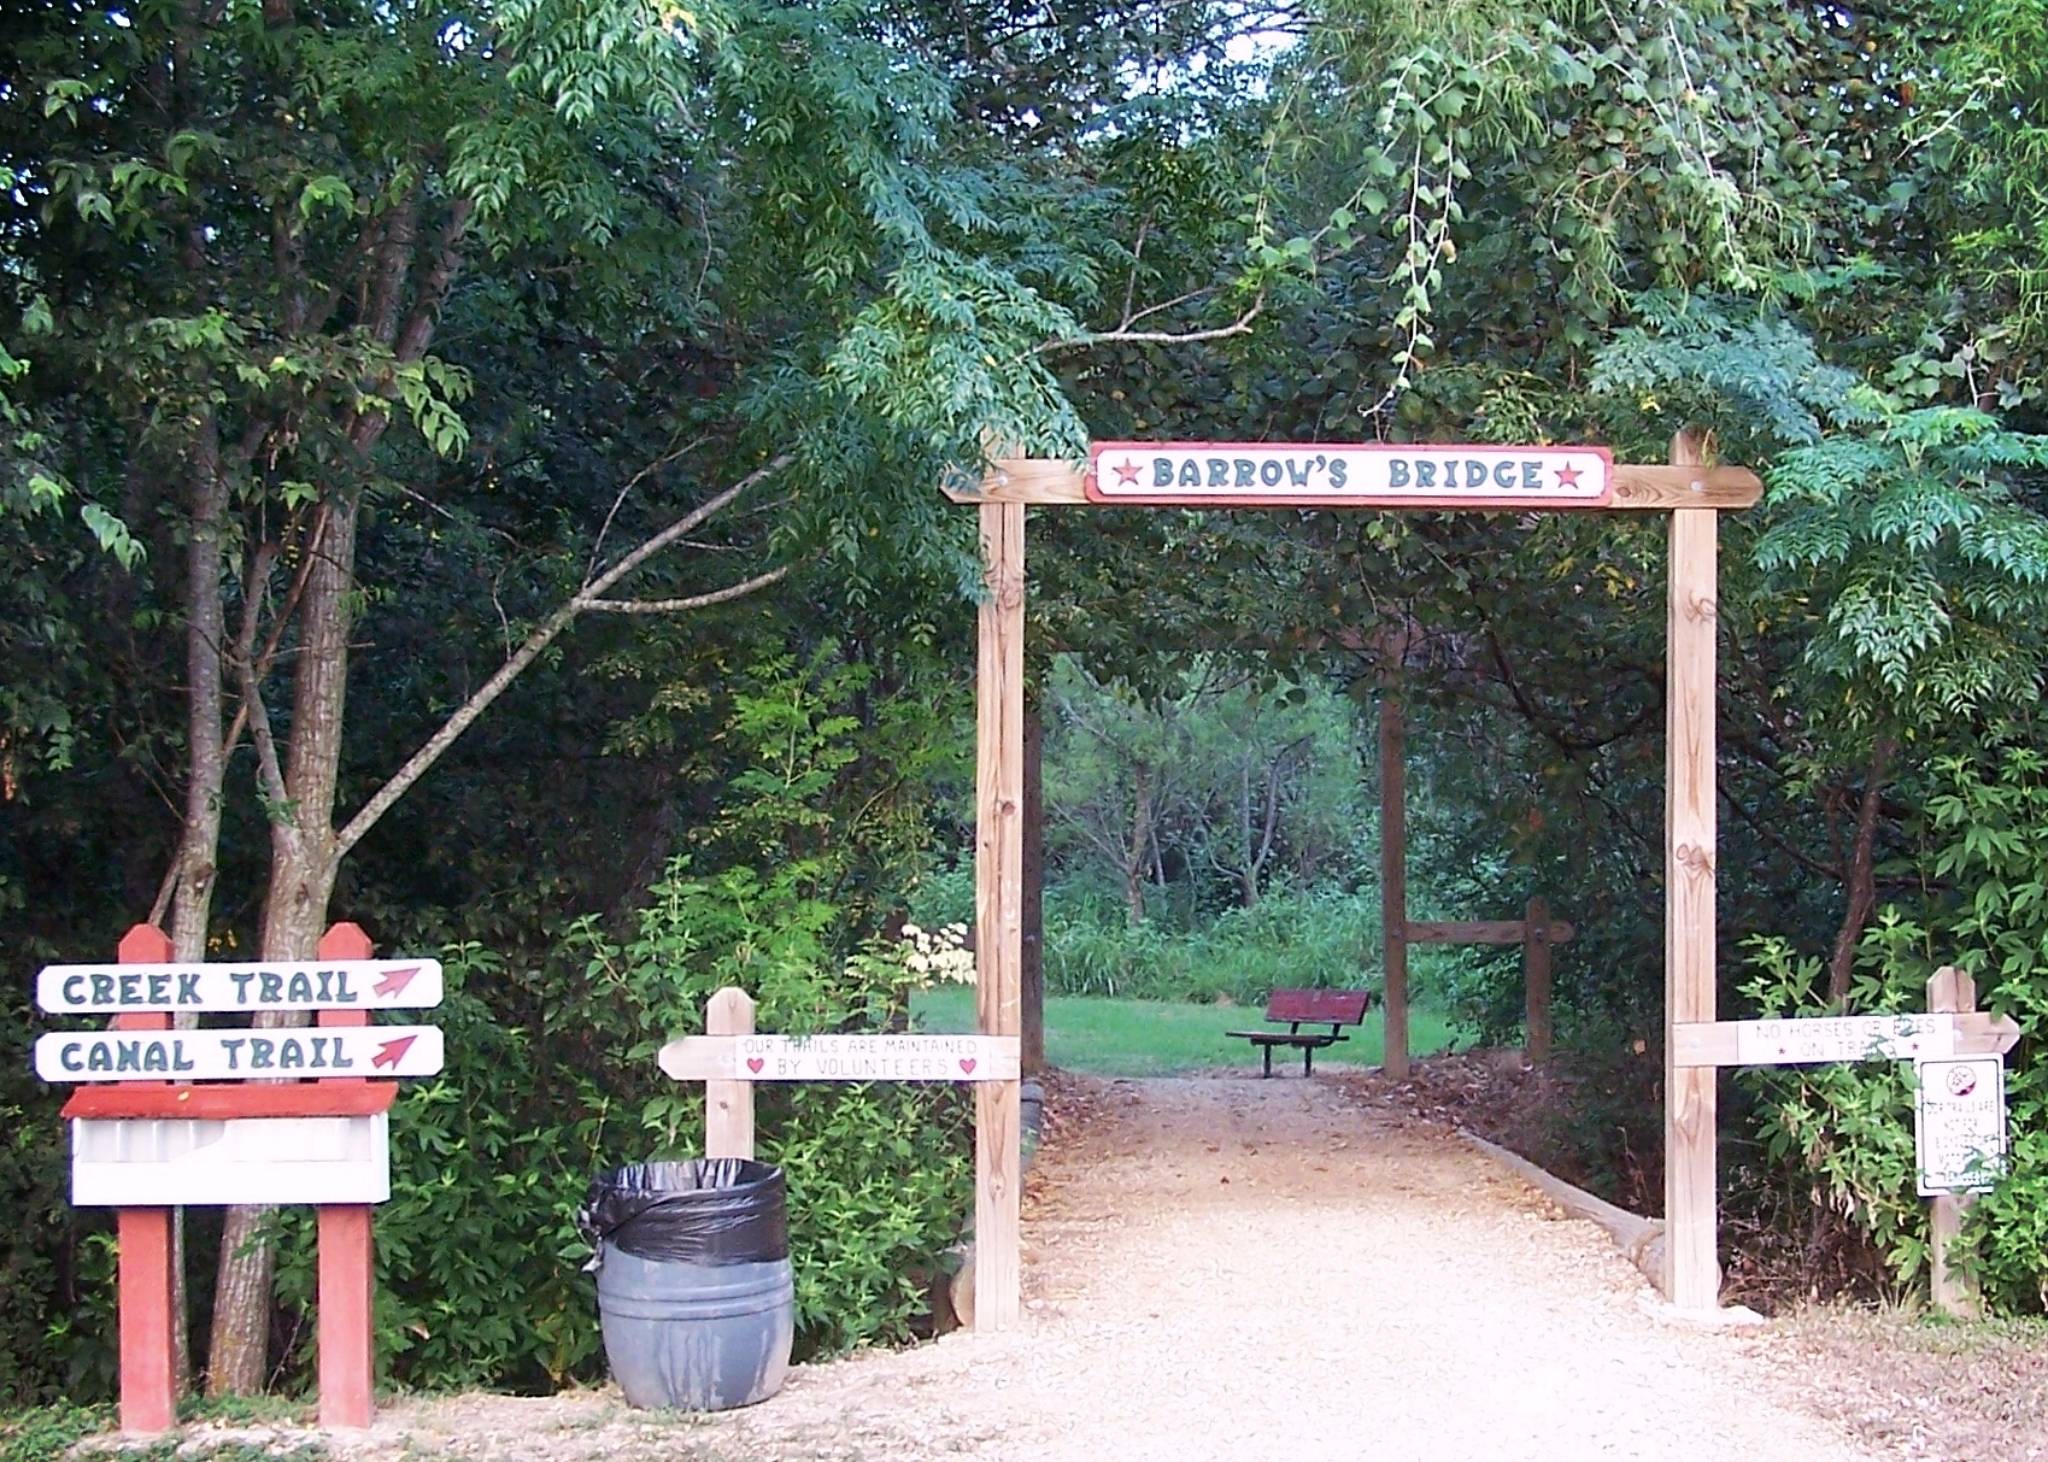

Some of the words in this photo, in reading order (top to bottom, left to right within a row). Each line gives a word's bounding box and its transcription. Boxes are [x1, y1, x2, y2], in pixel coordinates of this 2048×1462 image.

[1152, 455, 1348, 488] BARROW'S
[1388, 459, 1543, 488] BRIDGE
[62, 974, 203, 1005] CREEK
[229, 971, 358, 1004] TRAIL
[1755, 1023, 1781, 1039] NO
[1789, 1019, 1853, 1039] HORSES
[60, 1040, 194, 1072] CANAL
[221, 1037, 354, 1069] TRAIL
[744, 1038, 774, 1054] OUR
[847, 1039, 877, 1053] ARE
[884, 1039, 977, 1054] MAINTAINED
[1800, 1041, 1824, 1057] ON
[778, 1058, 801, 1075] BY
[817, 1058, 949, 1075] VOLUNTEERS
